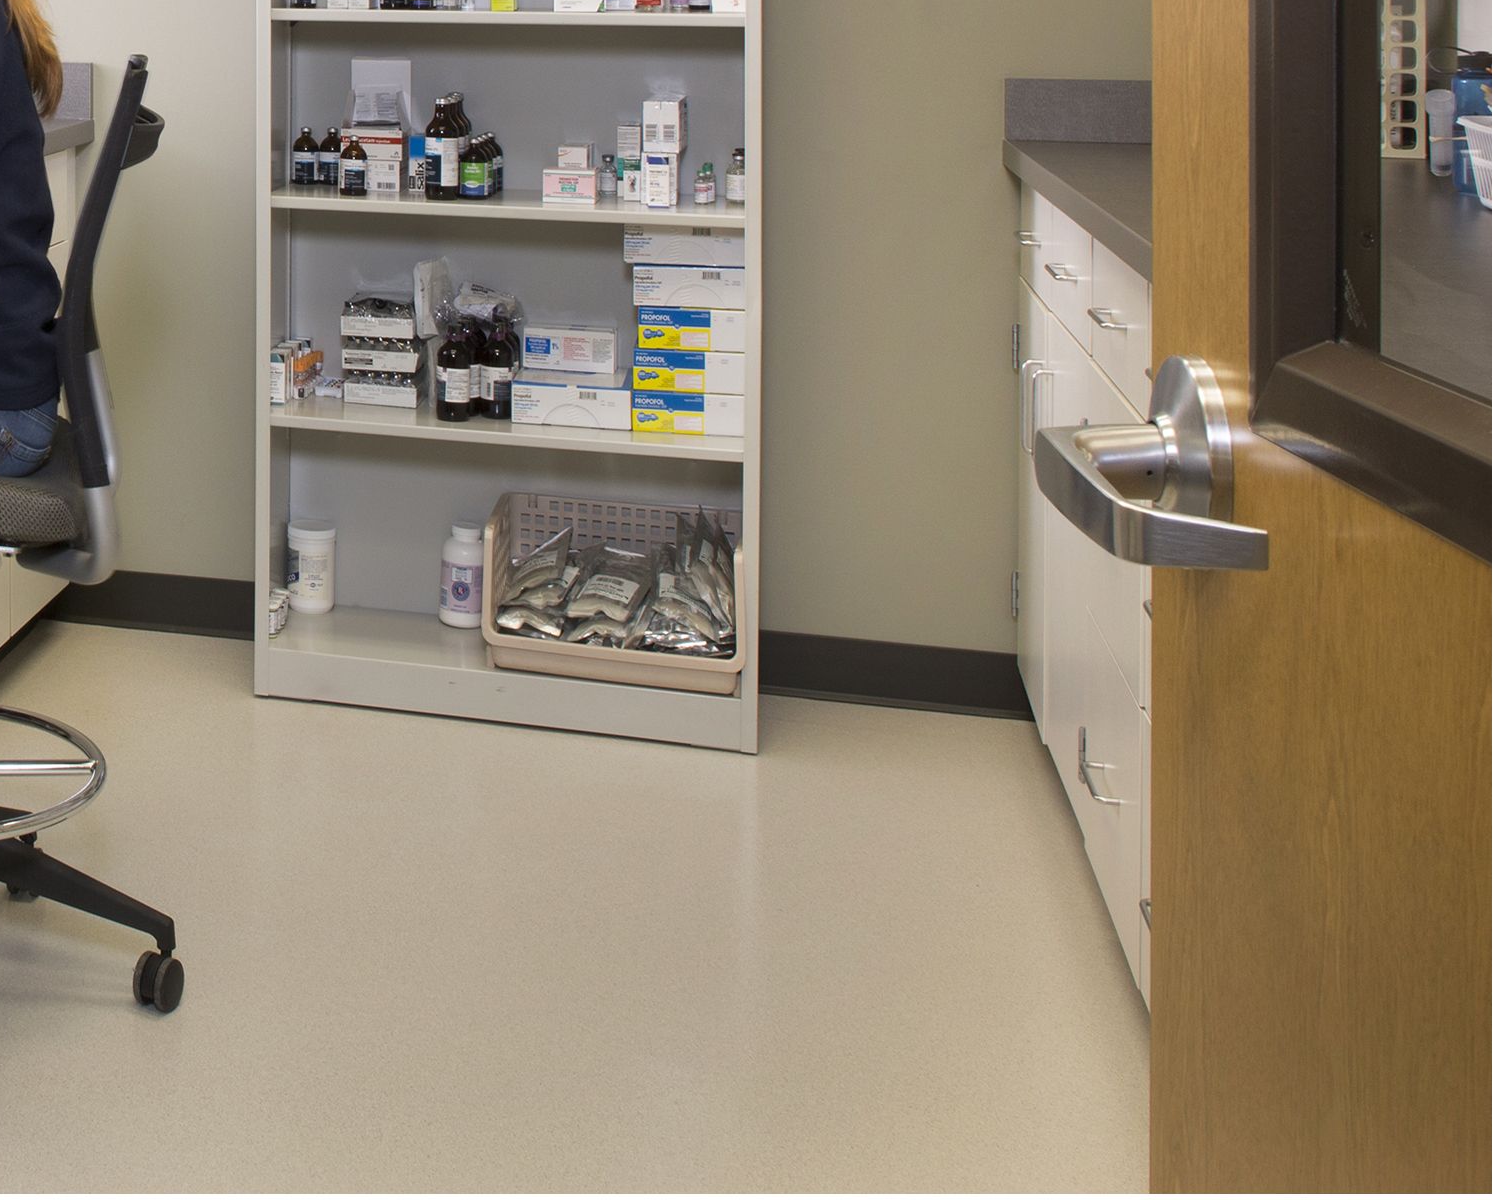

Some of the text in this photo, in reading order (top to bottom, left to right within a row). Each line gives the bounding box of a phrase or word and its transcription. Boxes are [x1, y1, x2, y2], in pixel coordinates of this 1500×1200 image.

[415, 162, 425, 190] salix
[640, 313, 671, 322] PROPOFOL
[635, 355, 665, 363] PROPOFOL
[634, 397, 664, 405] PROPOFOL
